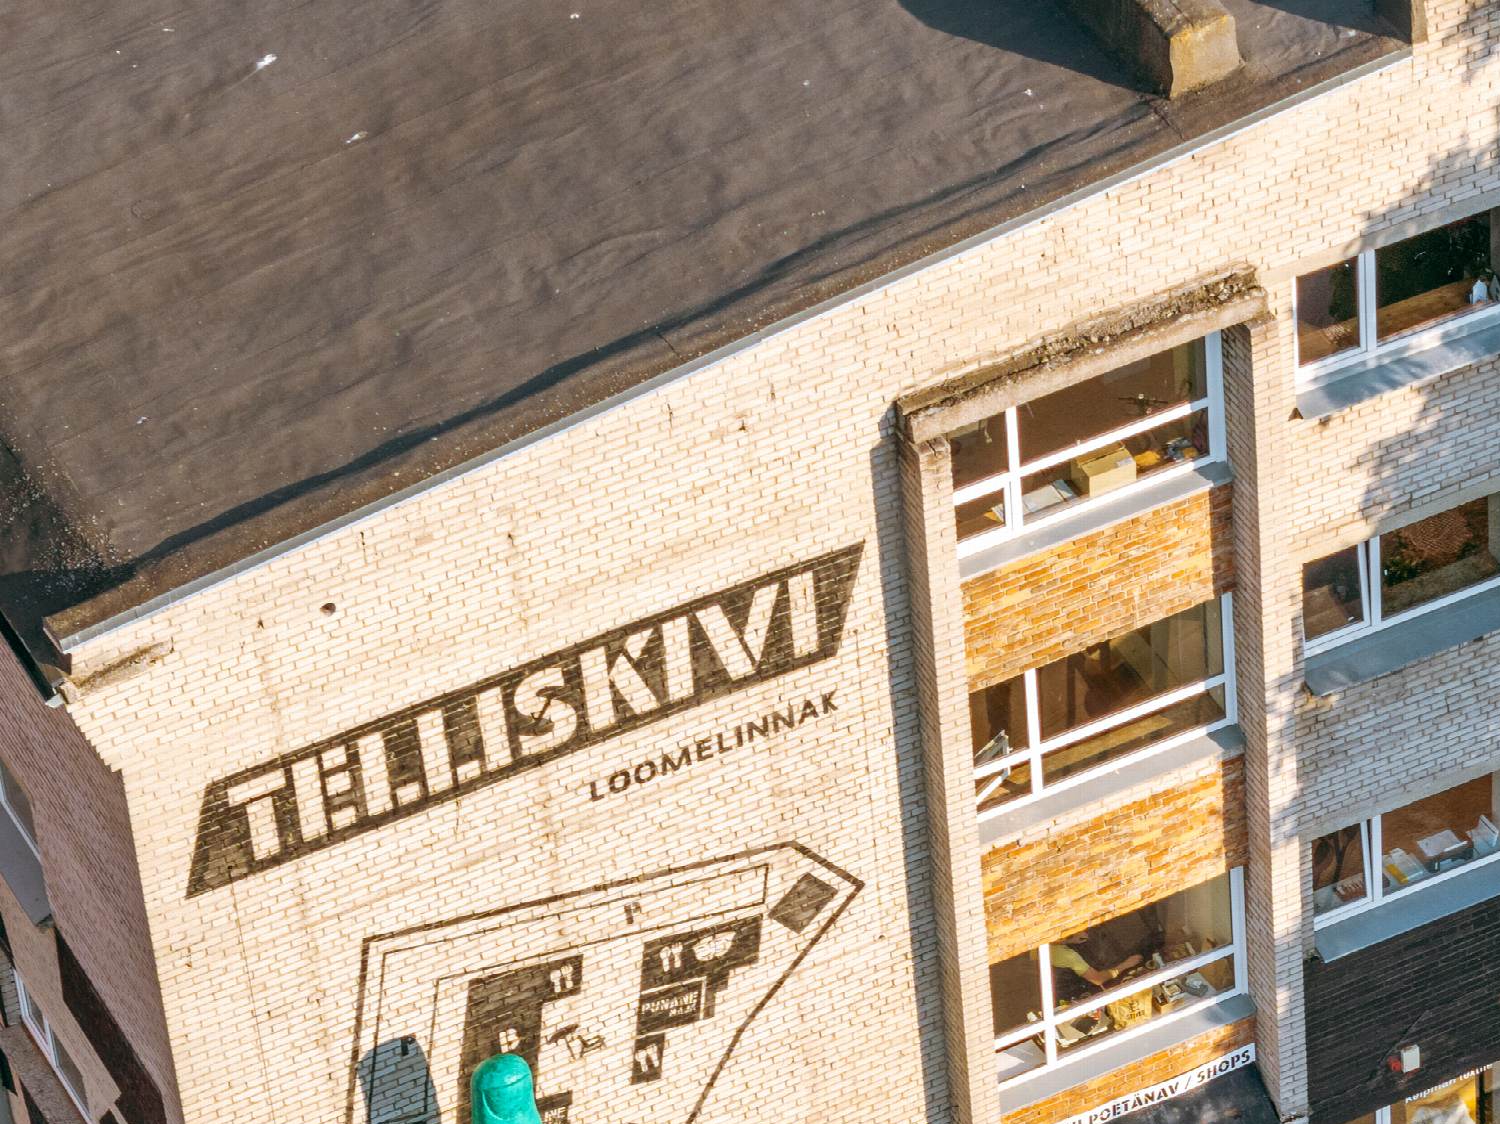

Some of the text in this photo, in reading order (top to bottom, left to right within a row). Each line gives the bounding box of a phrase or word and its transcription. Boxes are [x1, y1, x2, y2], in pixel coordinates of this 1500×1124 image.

[226, 568, 820, 862] TELLISKIVI
[588, 689, 839, 801] LOOMELINNAK
[642, 992, 699, 1014] PUNANE
[1197, 1049, 1251, 1083] SHOPS
